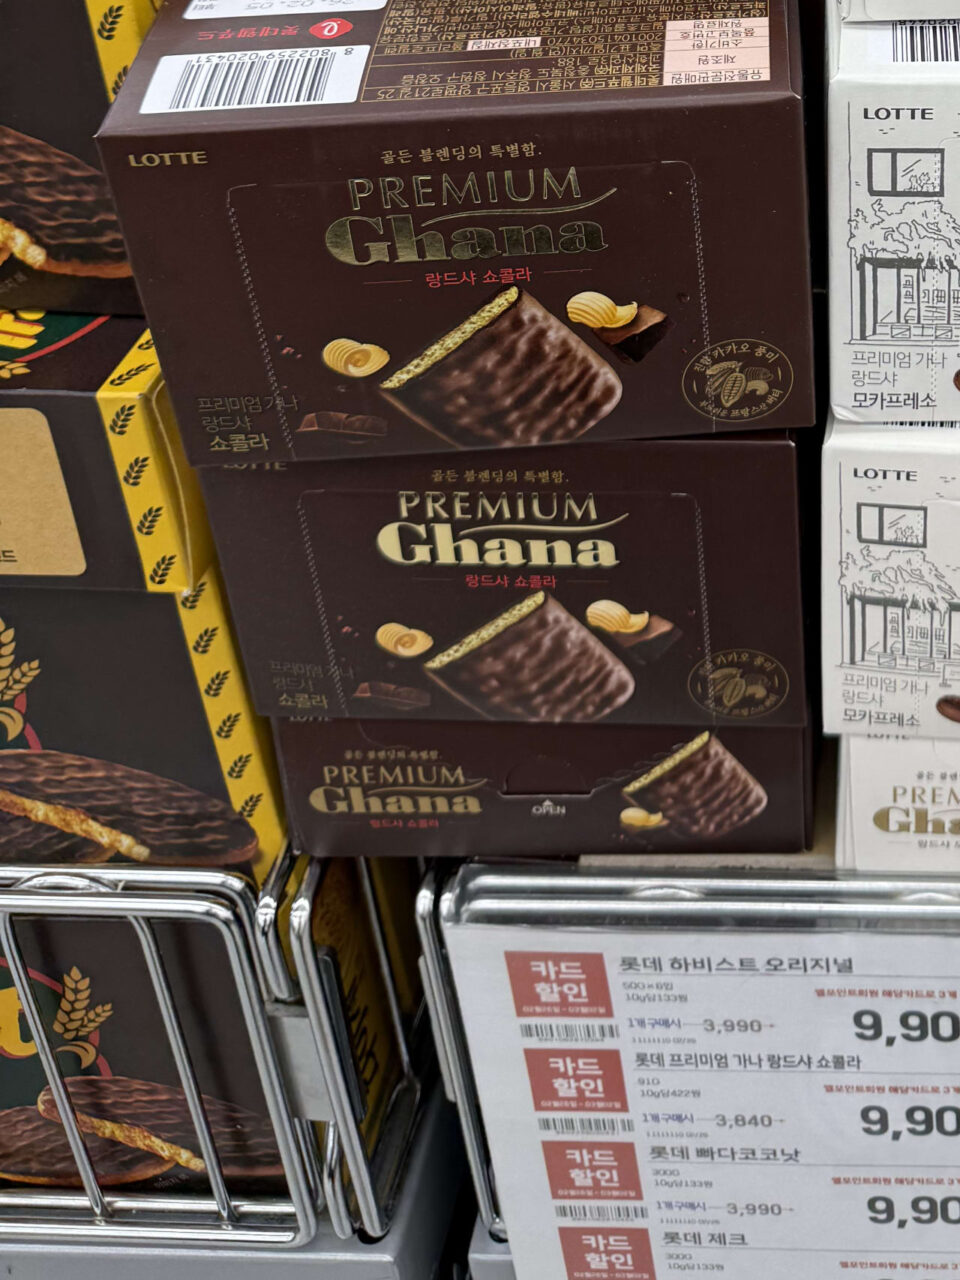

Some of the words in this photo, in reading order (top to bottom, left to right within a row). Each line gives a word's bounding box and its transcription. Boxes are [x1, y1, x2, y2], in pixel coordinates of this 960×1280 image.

[863, 108, 934, 121] LOTTE
[128, 151, 207, 167] LOTTE
[380, 145, 414, 165] 골든
[419, 142, 484, 163] 블렌딩의
[349, 166, 583, 210] PREMIUM
[325, 214, 609, 265] Ghana
[425, 268, 478, 288] 랑드샤
[482, 266, 533, 286] 쇼콜라
[851, 390, 938, 410] 모카프레소
[853, 468, 918, 482] LOTTE
[398, 491, 598, 520] PREMIUM
[376, 521, 619, 568] Ghana
[620, 957, 662, 972] 롯데
[669, 957, 759, 972] 하비스트
[765, 956, 853, 974] 오리지널
[635, 1053, 665, 1069] 롯데
[669, 1052, 728, 1068] 프리미엄
[732, 1053, 763, 1068] 가나
[816, 1055, 861, 1070] 쇼콜라
[650, 1147, 689, 1161] 롯데
[696, 1147, 800, 1162] 빠다코코낫
[664, 1232, 701, 1246] 롯데
[708, 1233, 748, 1246] 제크
